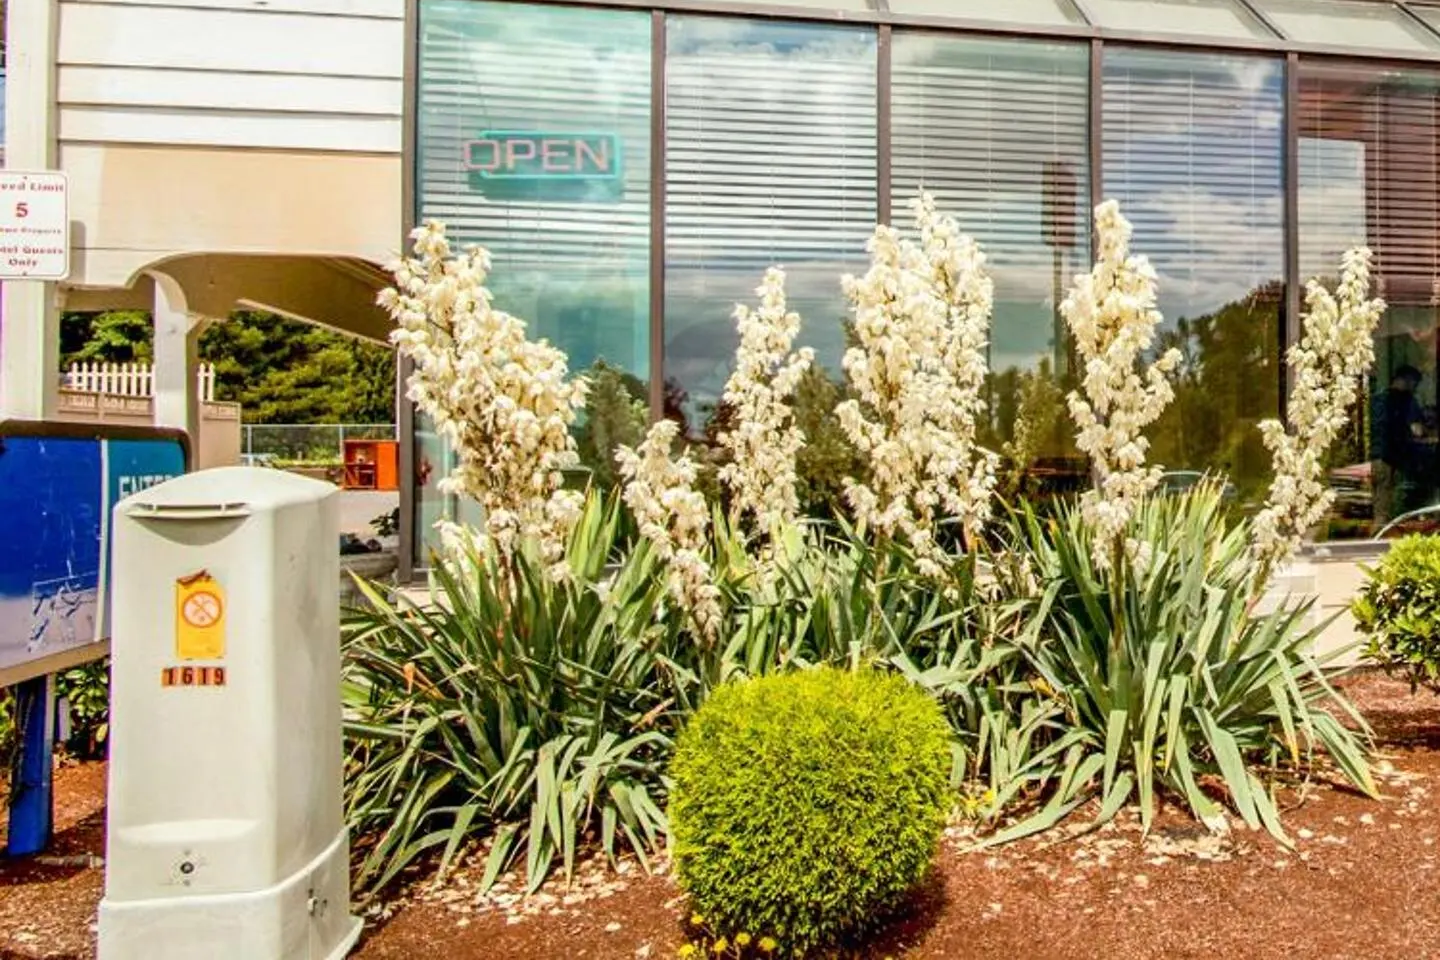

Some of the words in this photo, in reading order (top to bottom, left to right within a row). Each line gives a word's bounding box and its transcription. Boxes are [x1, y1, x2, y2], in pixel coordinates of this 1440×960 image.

[463, 138, 609, 171] OPEN
[0, 181, 26, 191] eed
[15, 201, 29, 218] 5
[164, 666, 225, 686] 1619
